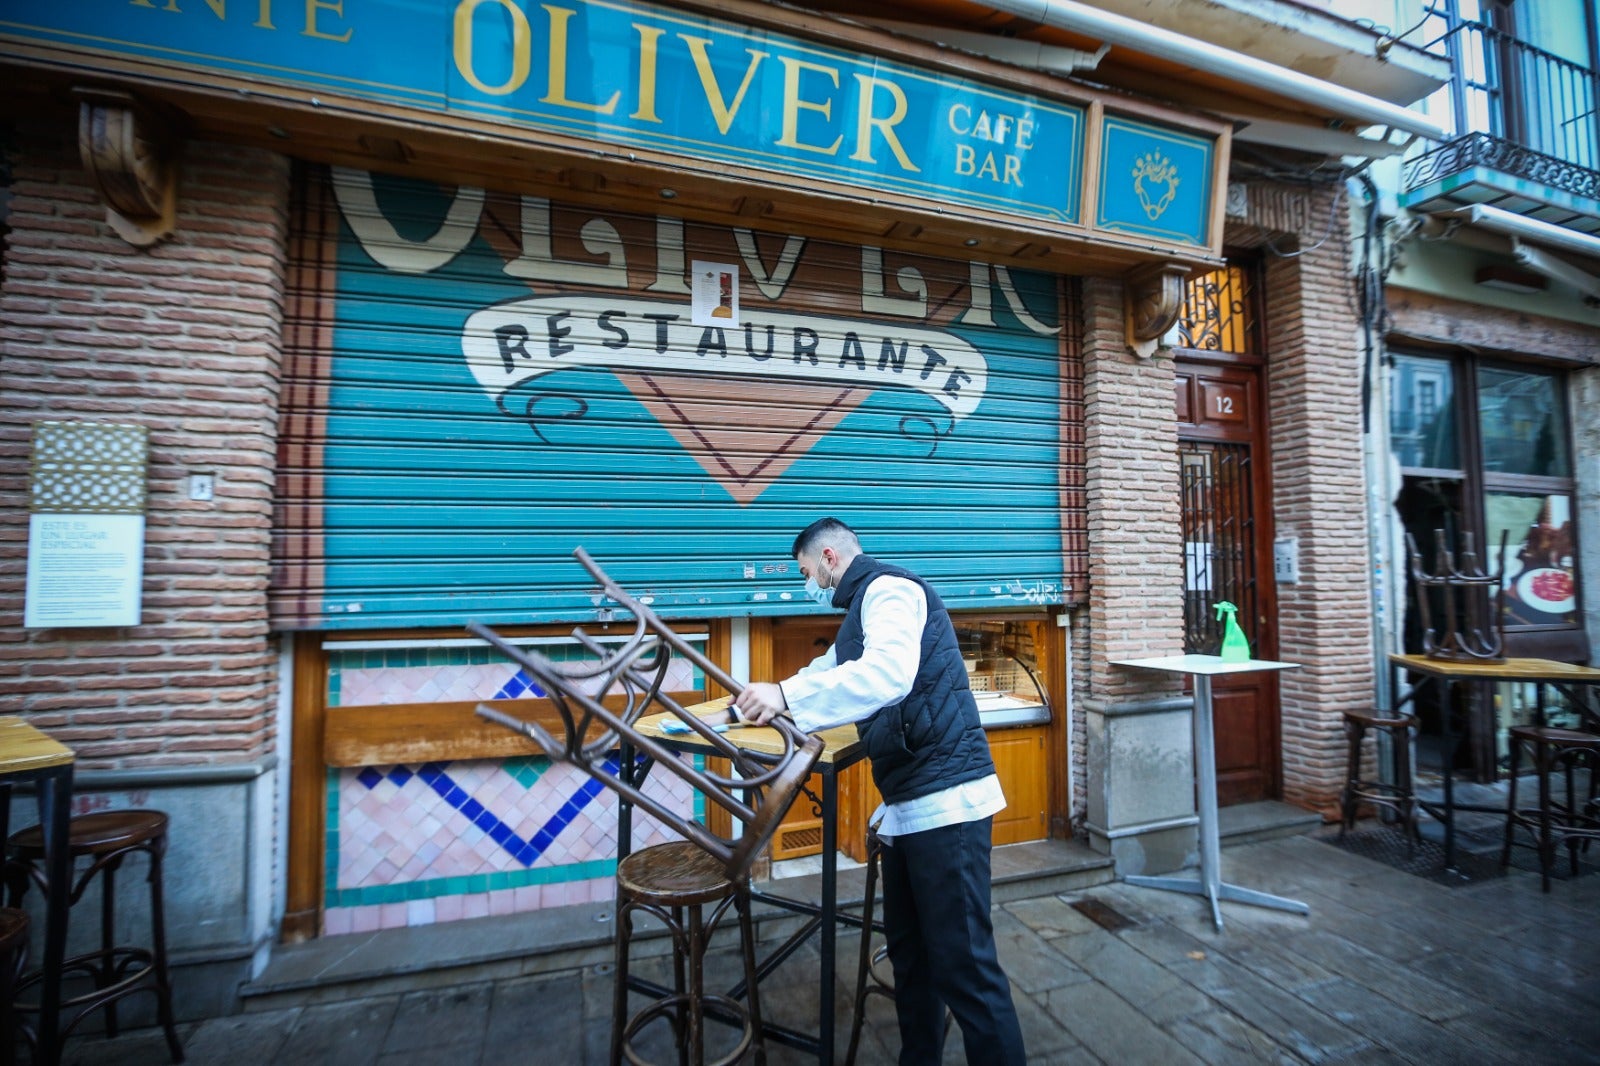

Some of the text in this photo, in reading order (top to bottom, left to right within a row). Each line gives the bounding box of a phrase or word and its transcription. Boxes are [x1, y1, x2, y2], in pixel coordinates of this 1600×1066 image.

[453, 0, 922, 173] OLIVER
[948, 103, 1034, 151] CAFÉ
[954, 142, 1024, 188] BAR
[493, 309, 972, 401] RESTAURANTE
[1215, 396, 1234, 414] 12
